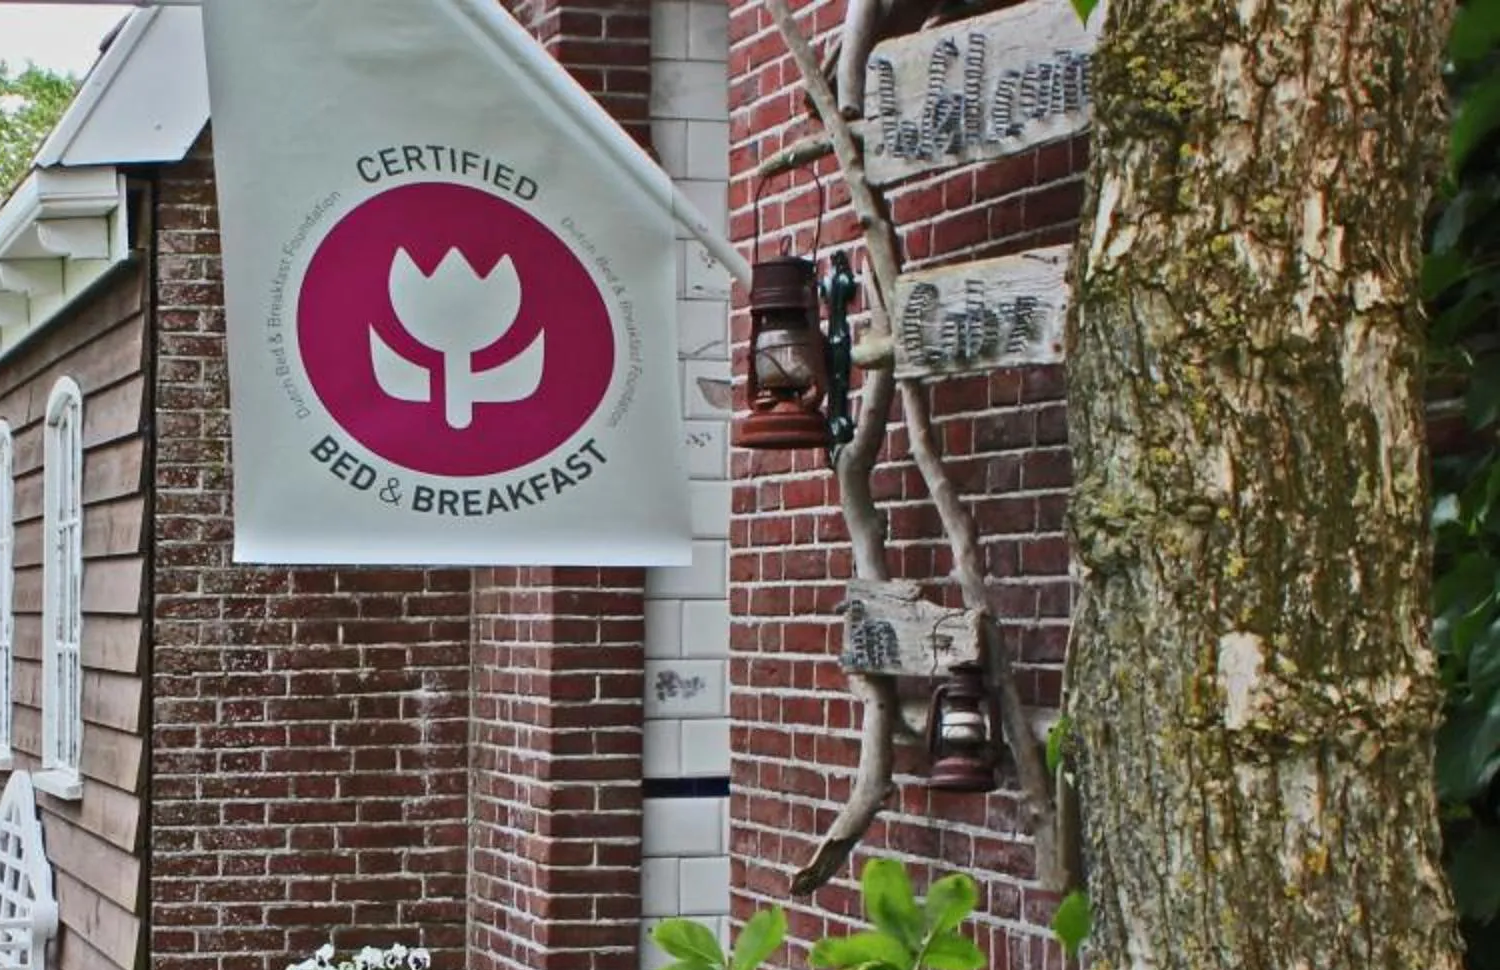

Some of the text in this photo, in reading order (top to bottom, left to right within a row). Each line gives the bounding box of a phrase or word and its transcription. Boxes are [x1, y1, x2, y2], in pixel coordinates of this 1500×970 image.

[356, 144, 539, 202] CERTIFIED
[267, 190, 342, 421] Dutch Bed & Breakfast Foundation
[309, 434, 609, 517] BED & BREAKFAST
